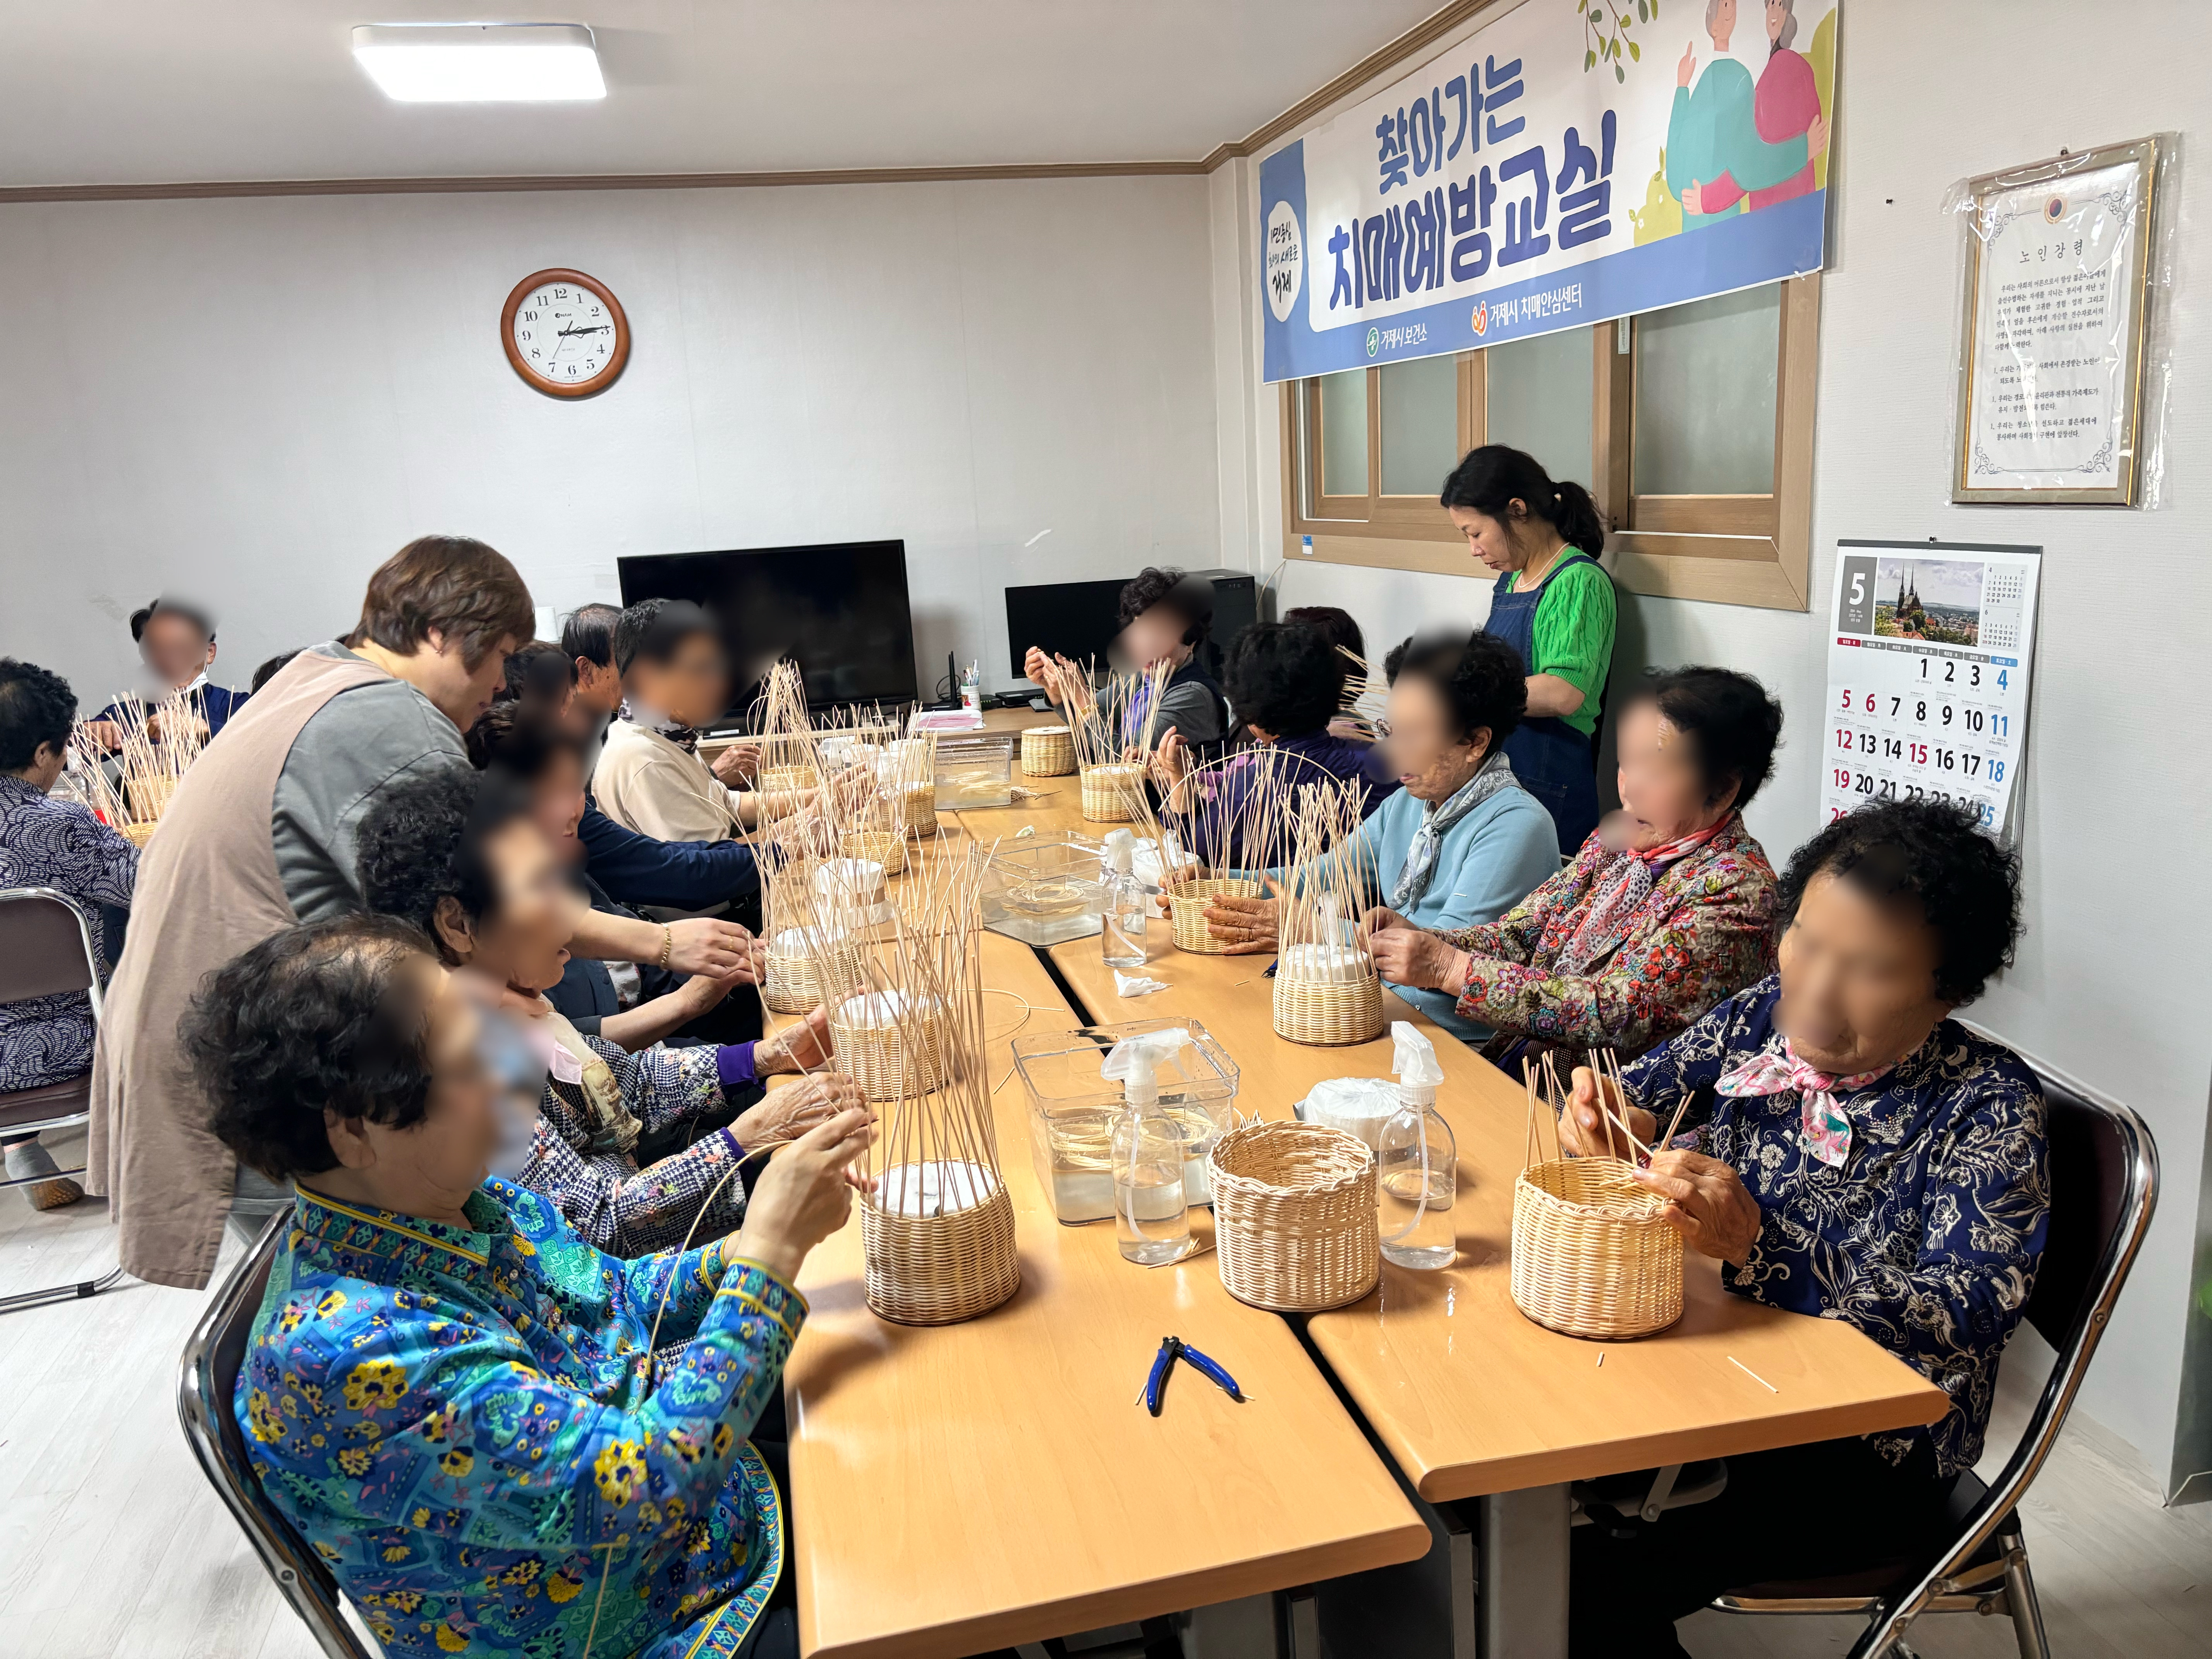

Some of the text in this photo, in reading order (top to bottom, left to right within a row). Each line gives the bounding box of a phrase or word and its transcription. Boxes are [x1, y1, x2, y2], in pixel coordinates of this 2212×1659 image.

[1376, 54, 1525, 196] 찾아가는
[1329, 109, 1617, 311] 치매예방교실
[1281, 244, 1298, 264] 새로운
[1273, 270, 1291, 303] 거제
[2001, 284, 2016, 292] 우리는
[2017, 281, 2032, 289] 사회의
[2034, 276, 2059, 287] 어른으로서
[2048, 289, 2063, 297] 지니는
[2085, 283, 2096, 292] 지난
[553, 288, 567, 299] 12
[576, 293, 584, 304] 1
[536, 295, 549, 306] 11
[1491, 283, 1582, 328] 거제시 치매안심센터
[2035, 302, 2051, 311] 고귀한
[2087, 295, 2104, 304] 그리고
[524, 311, 538, 322] 10
[591, 306, 600, 317] 2
[601, 325, 610, 335] 3
[2086, 319, 2103, 328] 위하여
[522, 330, 531, 341] 9
[1381, 323, 1427, 350] 거제시 보건소
[531, 348, 541, 359] 8
[596, 344, 605, 354] 4
[548, 362, 556, 373] 7
[568, 365, 577, 375] 6
[586, 359, 595, 369] 5
[2039, 361, 2059, 370] 사회에서
[2083, 357, 2100, 365] 노인이
[1849, 573, 1865, 605] 5
[1921, 658, 2008, 690] 1 2 3 4
[1842, 689, 2008, 737] 5 6 7 8 9 10 11
[1836, 729, 1852, 749] 12
[1860, 734, 1876, 754] 13
[1884, 738, 1901, 759] 14
[1910, 743, 1927, 764] 15
[1936, 749, 1954, 770] 16
[1962, 754, 1980, 775] 17
[1988, 760, 2004, 782] 18
[1834, 769, 1850, 788] 19
[1855, 774, 1873, 794] 20
[1879, 779, 1896, 800] 21
